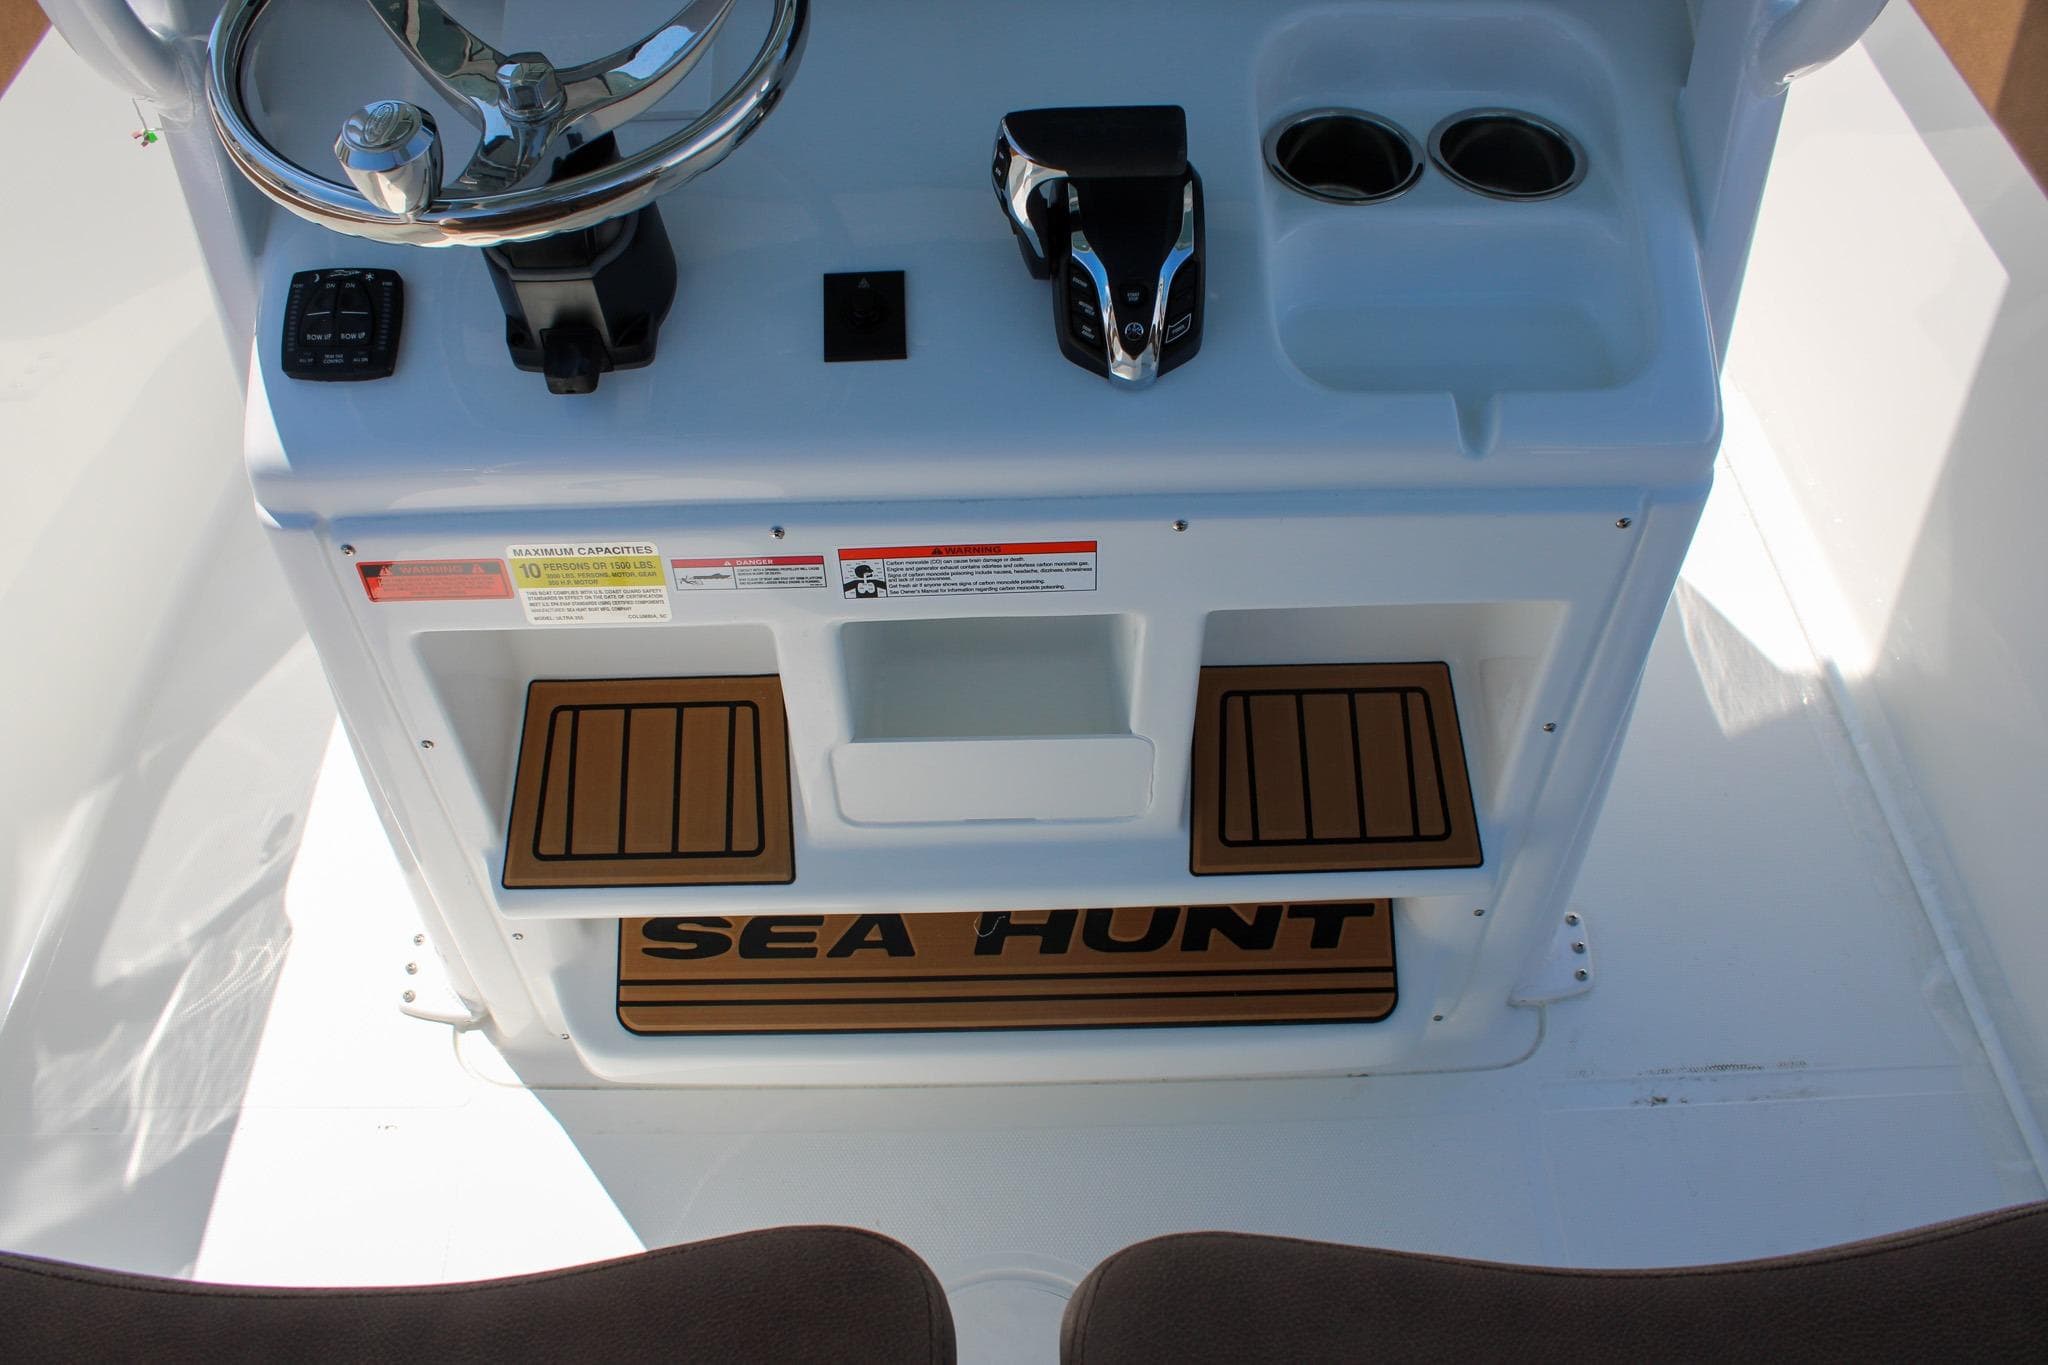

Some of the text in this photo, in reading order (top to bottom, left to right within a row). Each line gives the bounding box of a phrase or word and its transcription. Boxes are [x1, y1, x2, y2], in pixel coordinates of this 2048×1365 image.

[512, 546, 653, 557] MAXIMUM CAPACITIES
[944, 545, 1002, 555] WARNING
[519, 562, 541, 578] 10
[543, 560, 656, 571] PERSONS OR 1500 LBS.
[642, 903, 1375, 959] SEA HUNT
